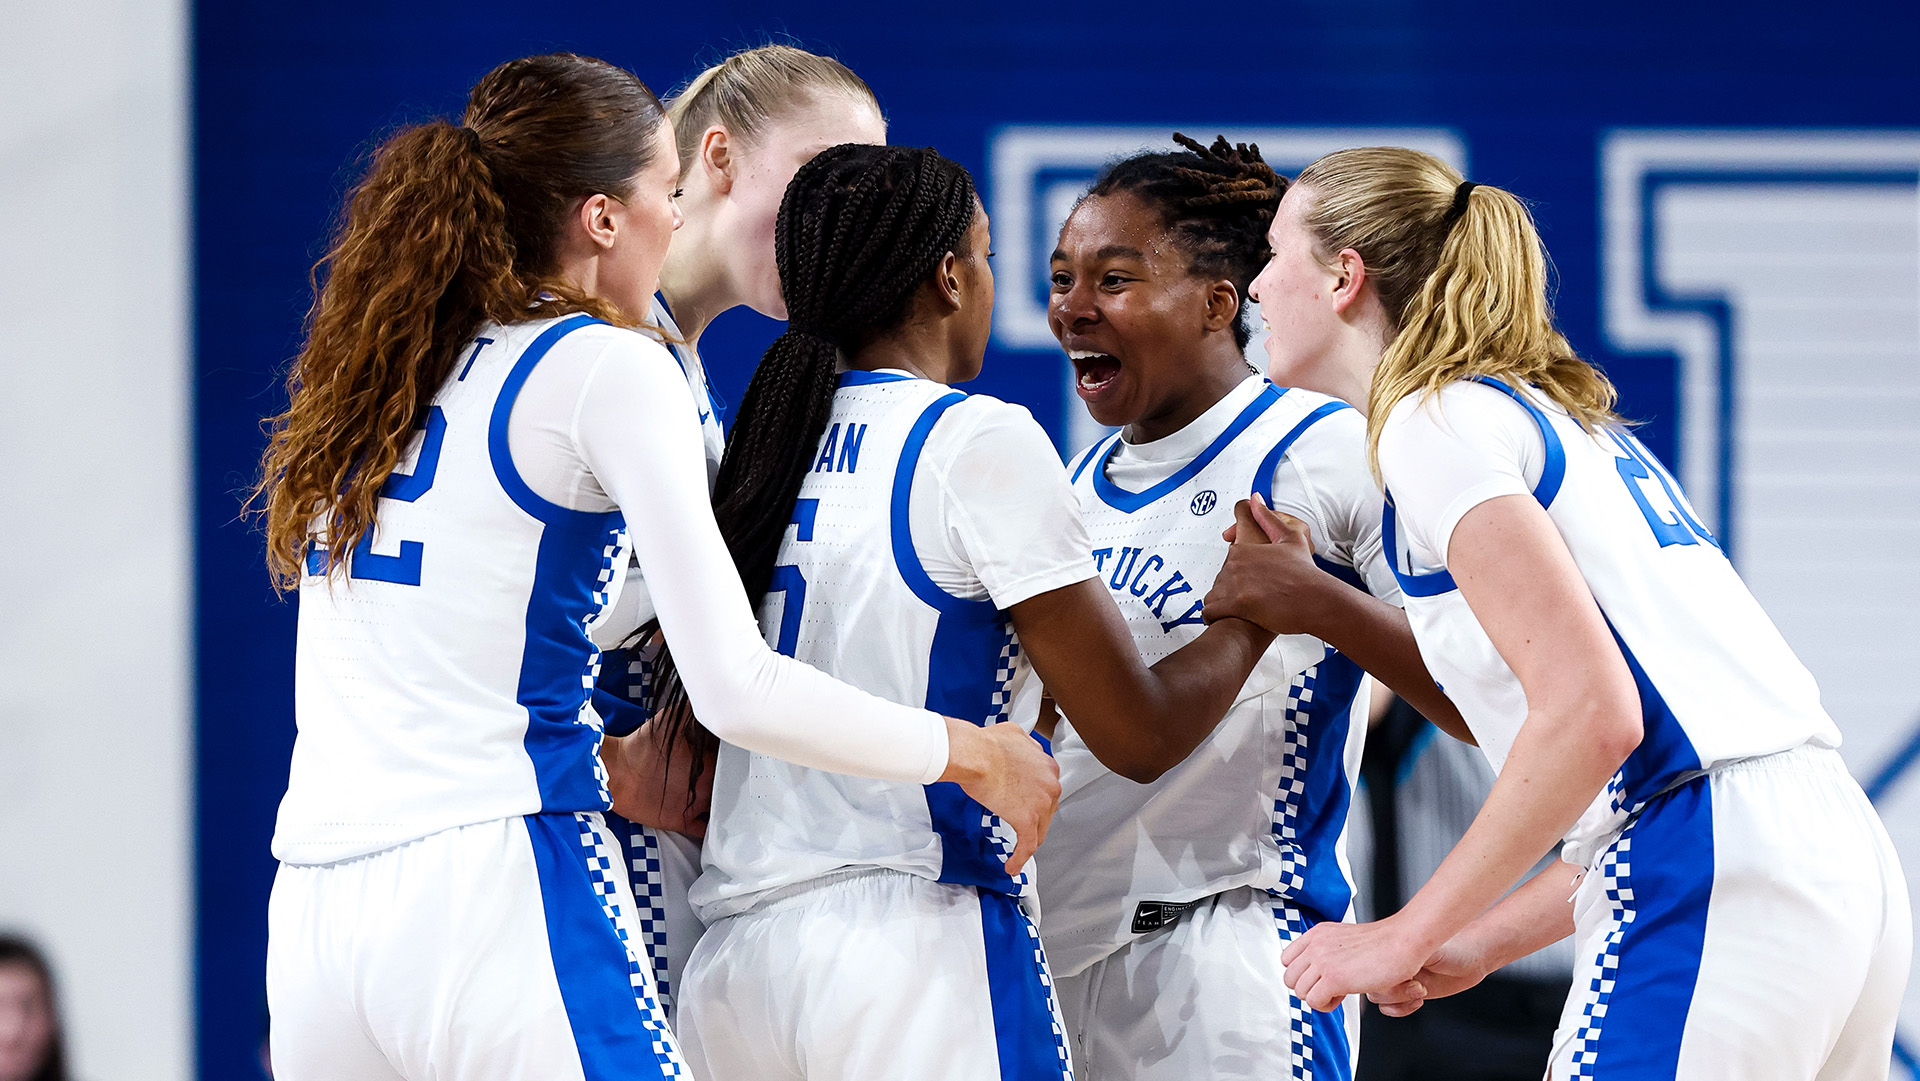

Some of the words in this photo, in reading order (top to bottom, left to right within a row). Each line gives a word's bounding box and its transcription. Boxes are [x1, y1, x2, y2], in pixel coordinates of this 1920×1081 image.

[808, 422, 868, 473] AN
[308, 405, 448, 586] 2
[1191, 491, 1216, 515] SEC
[1091, 546, 1209, 635] TUCKY
